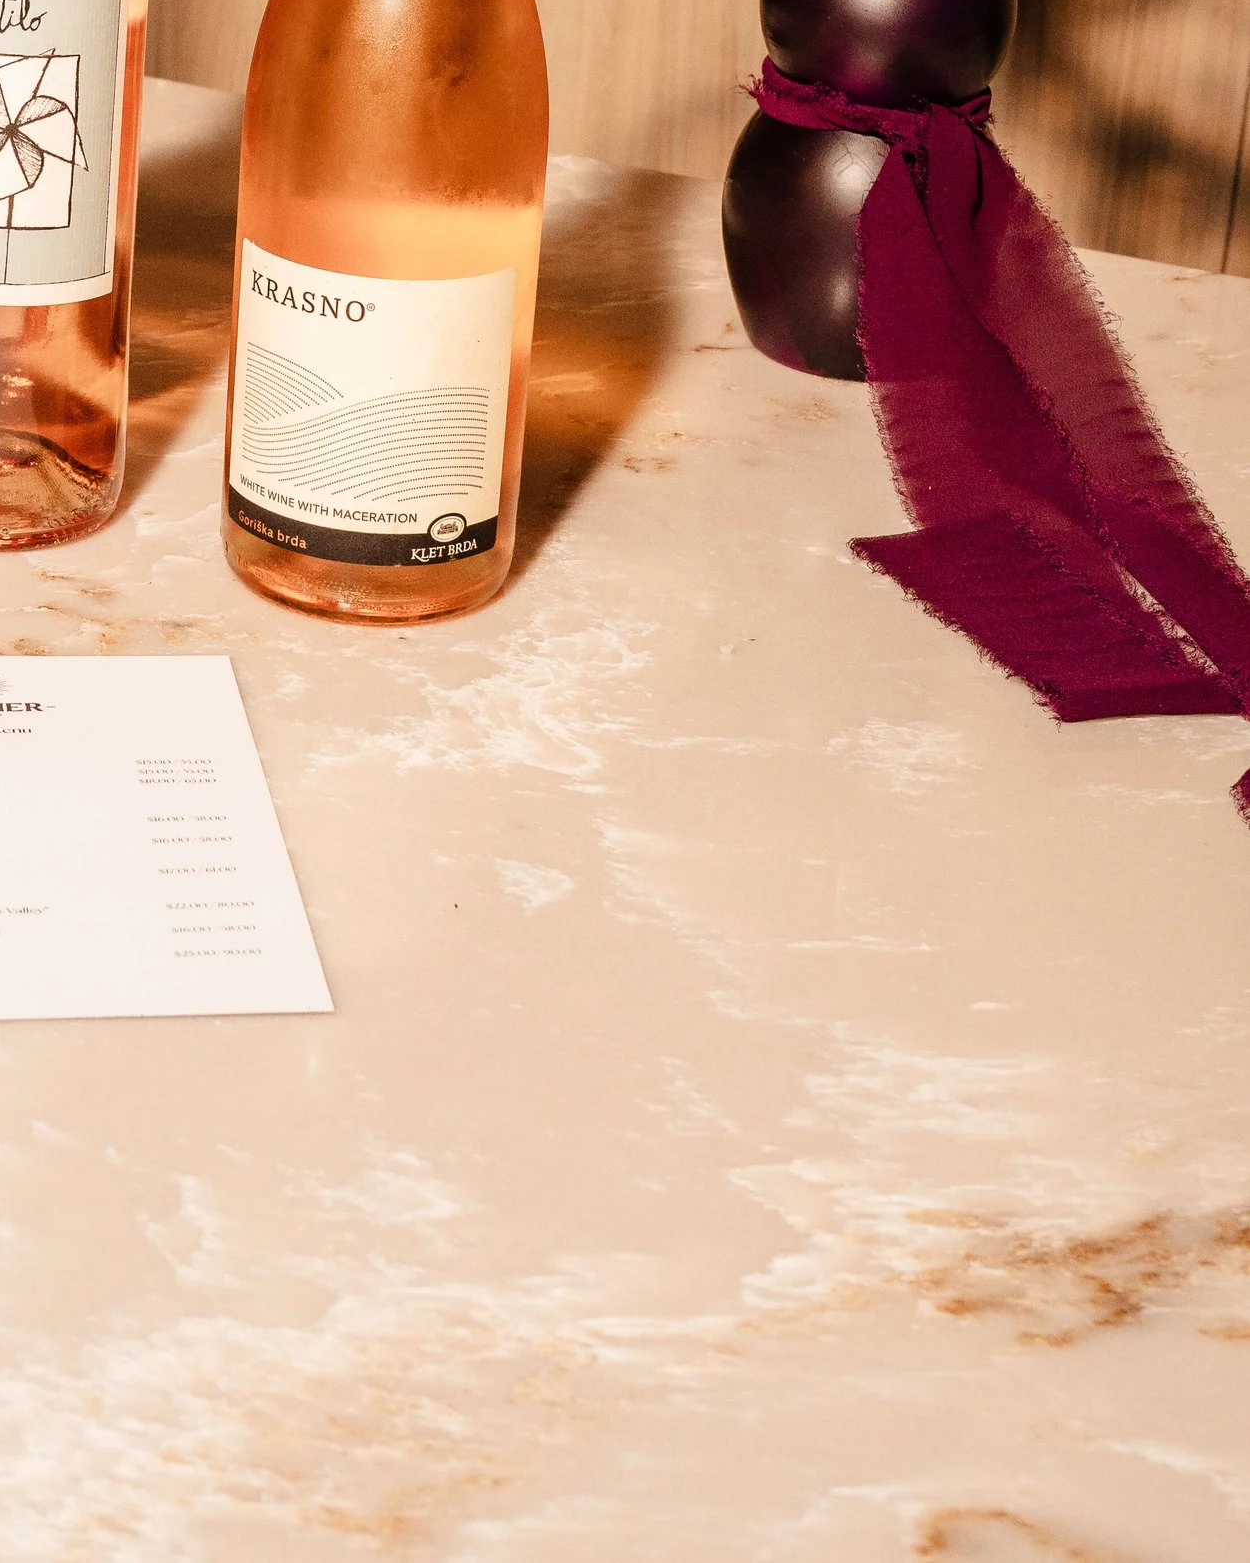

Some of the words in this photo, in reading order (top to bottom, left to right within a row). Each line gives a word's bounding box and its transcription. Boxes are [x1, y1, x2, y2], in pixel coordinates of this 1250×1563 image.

[240, 473, 266, 498] WHITE
[267, 490, 295, 508] WINE
[298, 499, 329, 517] WITH
[332, 507, 418, 524] MACERATION
[238, 510, 275, 540] Goriška
[277, 530, 307, 550] brda
[410, 545, 446, 563] KLET
[448, 538, 478, 556] BRDA
